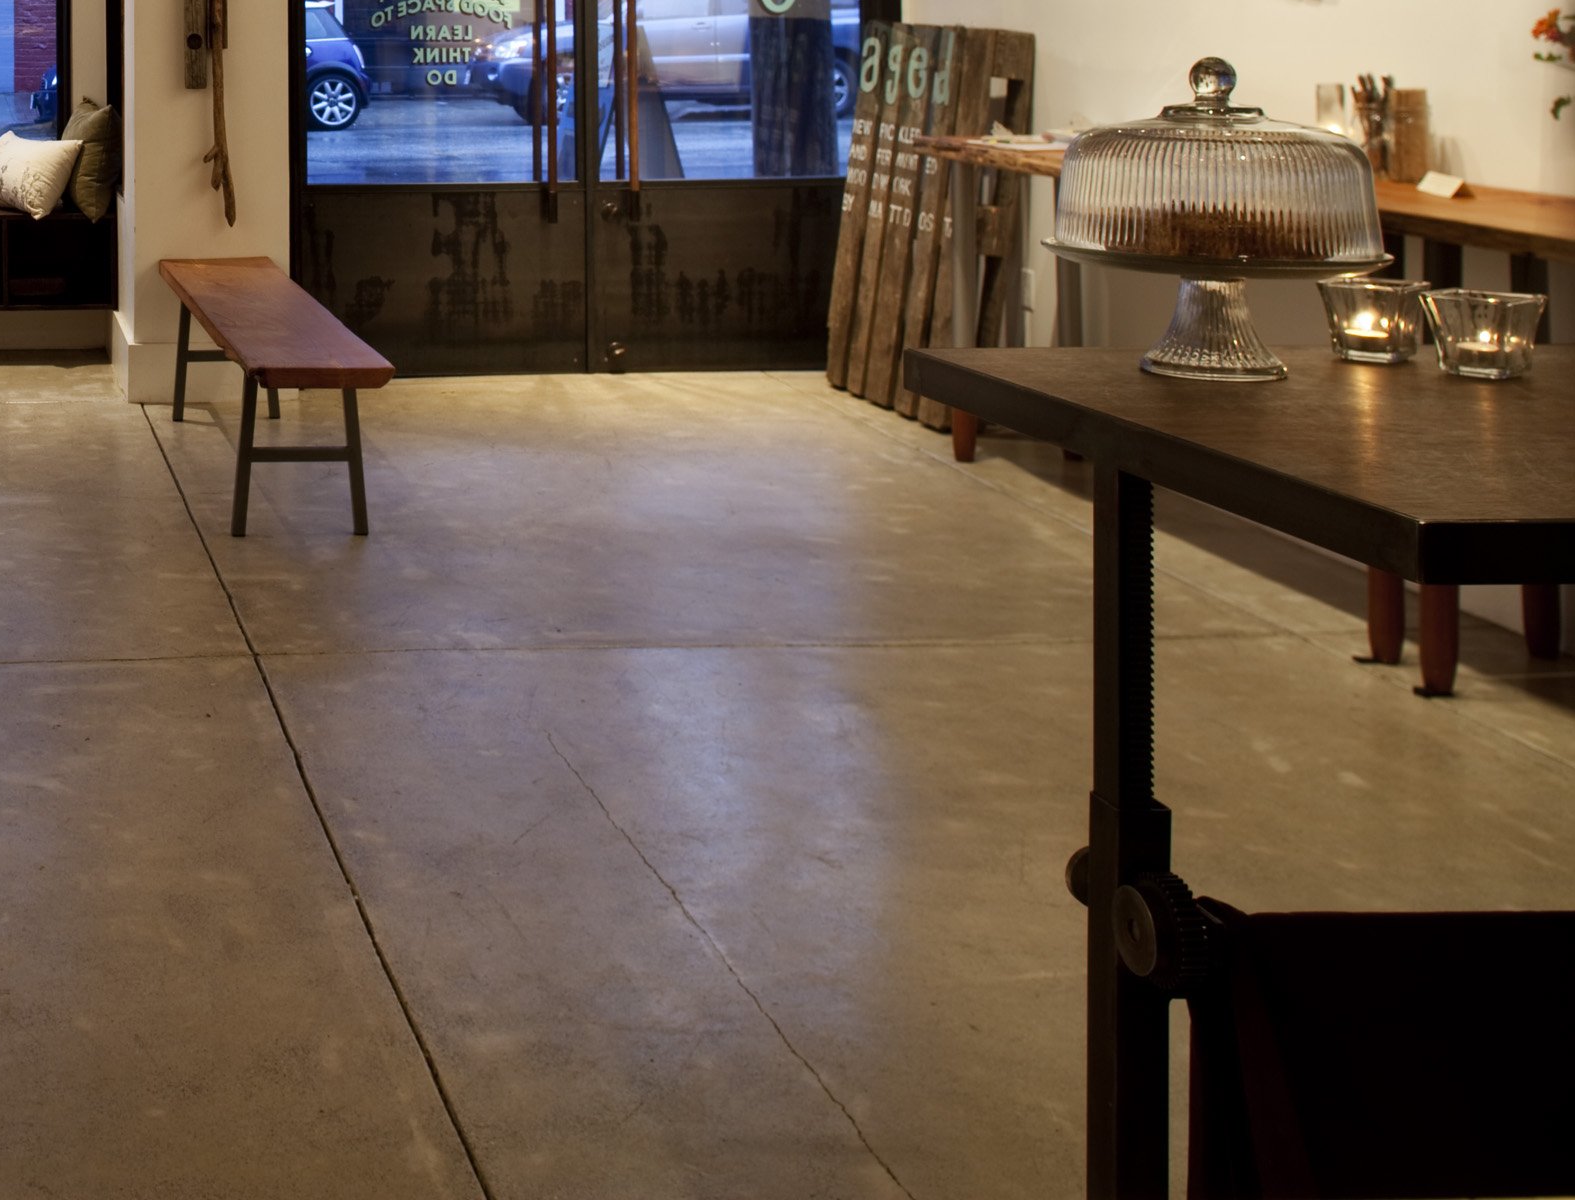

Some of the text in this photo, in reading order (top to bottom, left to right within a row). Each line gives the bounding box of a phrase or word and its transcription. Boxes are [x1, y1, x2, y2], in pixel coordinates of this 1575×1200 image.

[859, 30, 955, 106] aged
[849, 142, 868, 161] AND
[841, 192, 855, 212] BY
